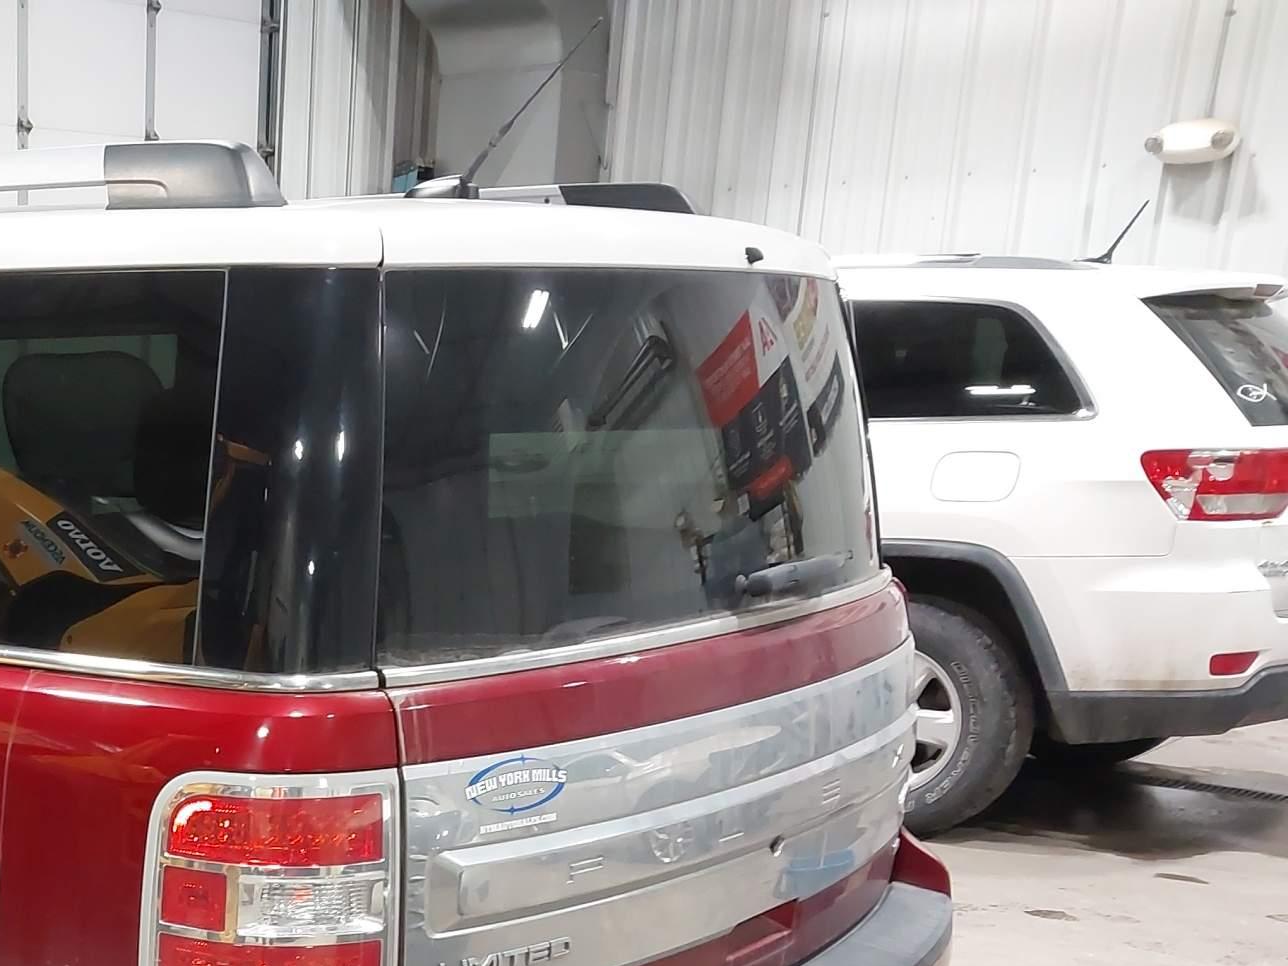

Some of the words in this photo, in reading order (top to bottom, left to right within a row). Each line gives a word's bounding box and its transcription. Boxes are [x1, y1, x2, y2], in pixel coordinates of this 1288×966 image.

[464, 777, 498, 801] NEW
[498, 769, 530, 787] YORK
[531, 768, 568, 784] MILLS
